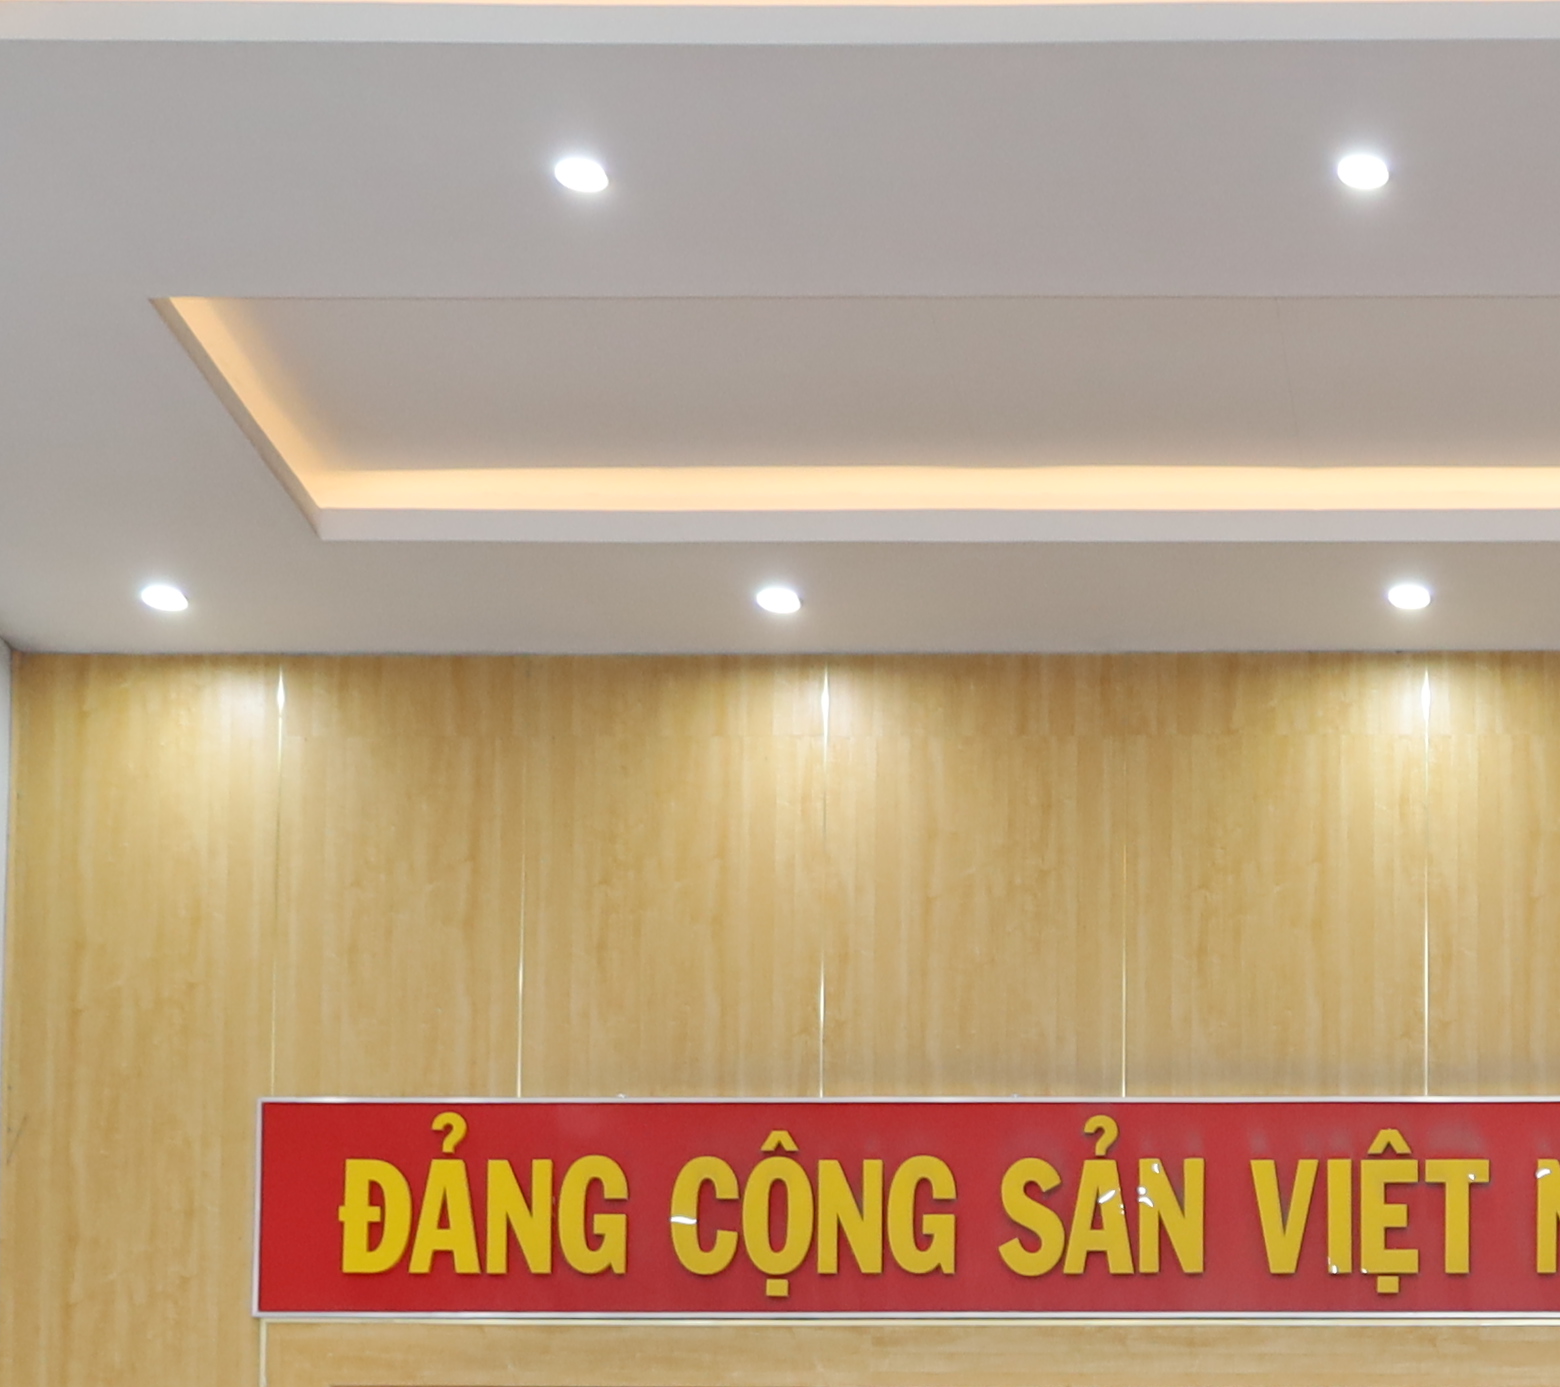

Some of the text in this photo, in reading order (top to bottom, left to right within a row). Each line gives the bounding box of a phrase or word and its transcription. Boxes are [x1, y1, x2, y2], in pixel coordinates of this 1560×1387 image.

[339, 1112, 628, 1273] ĐẢNG
[670, 1131, 956, 1295] CỘNG
[998, 1115, 1204, 1276] SẢN
[1250, 1128, 1489, 1293] VIỆT
